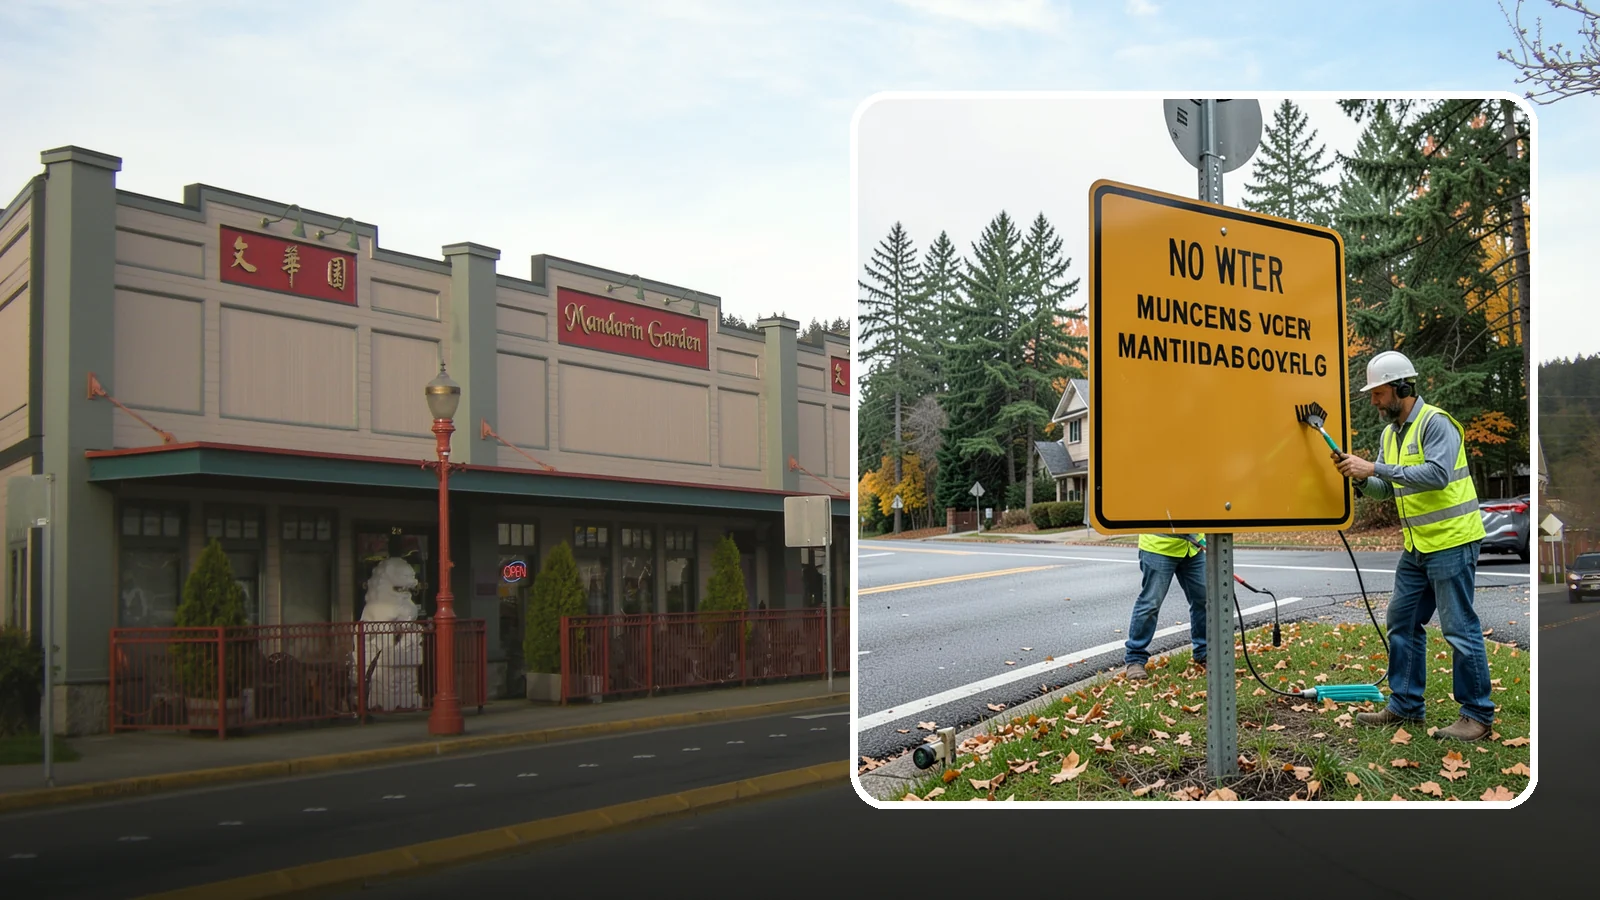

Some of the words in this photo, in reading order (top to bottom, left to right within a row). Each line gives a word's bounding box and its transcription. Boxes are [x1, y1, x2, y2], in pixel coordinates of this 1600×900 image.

[231, 236, 347, 291] 文華園
[1169, 237, 1204, 281] NO
[1215, 245, 1284, 295] WTER
[564, 302, 644, 341] Mandarin
[648, 319, 702, 353] Garden
[1137, 294, 1252, 333] MUNCENS
[503, 565, 527, 578] OPEN
